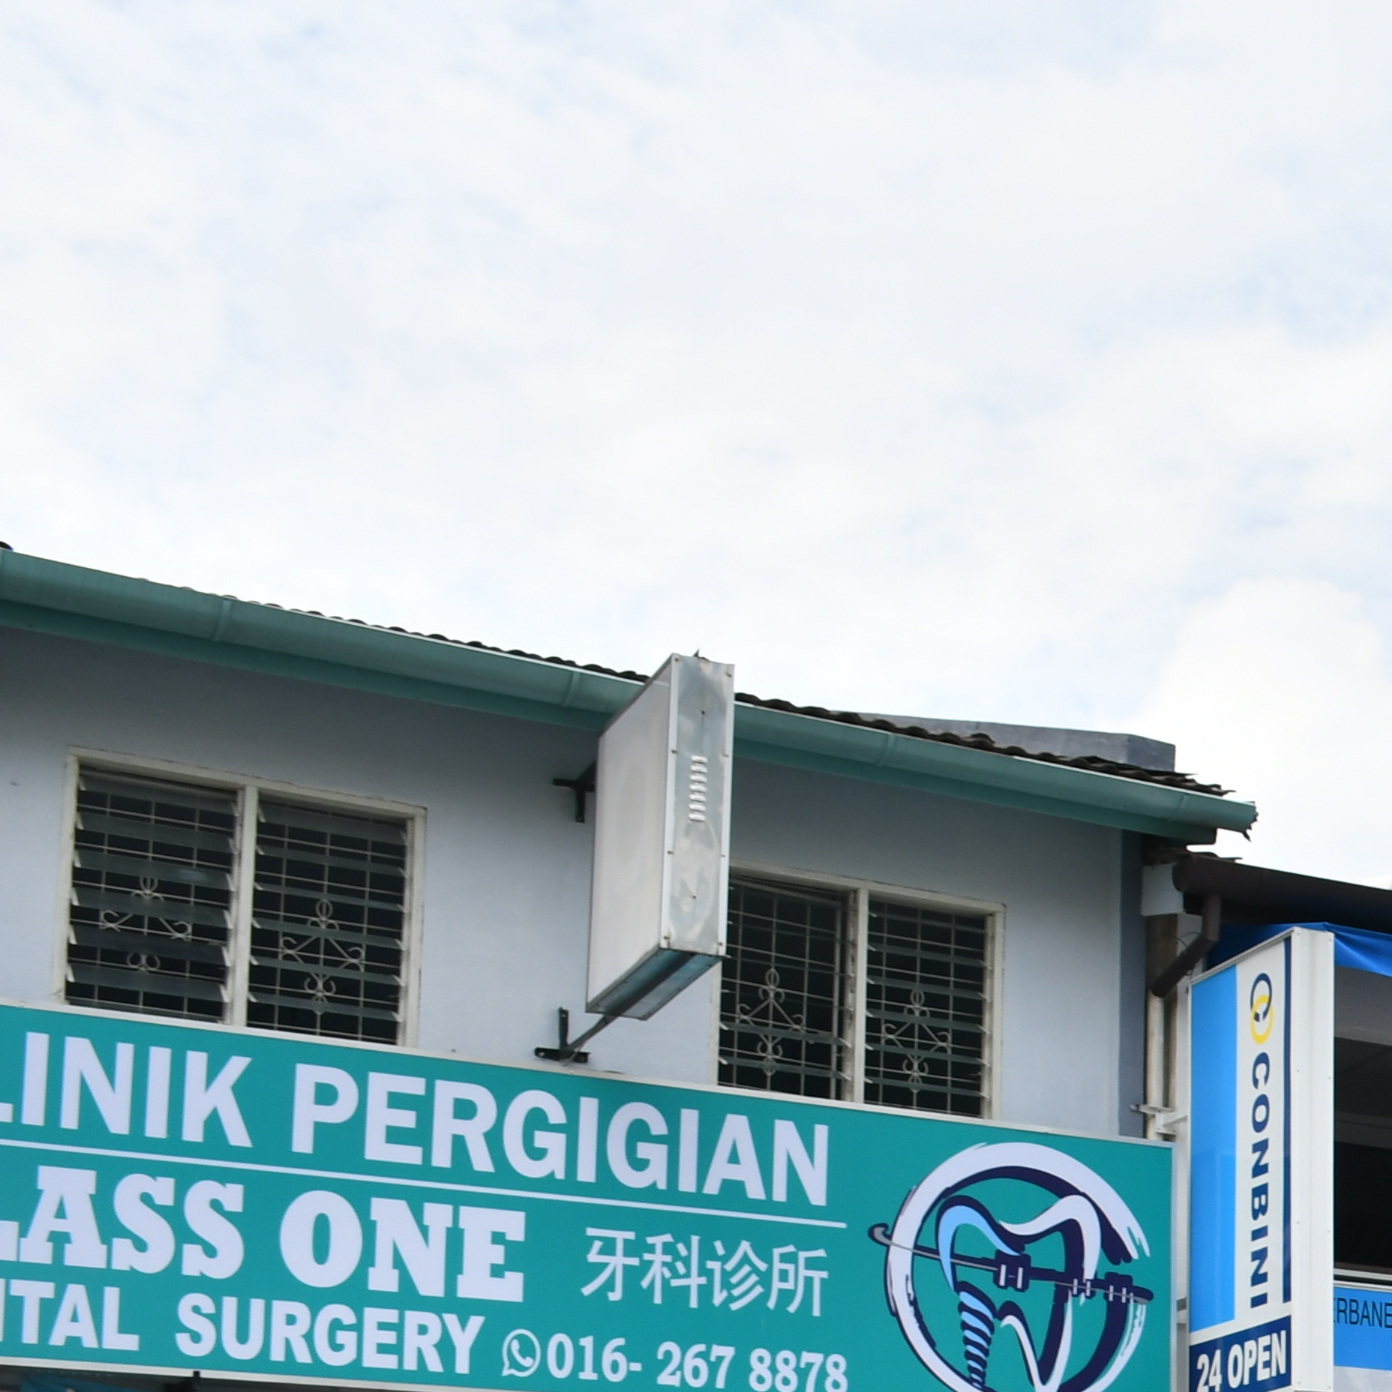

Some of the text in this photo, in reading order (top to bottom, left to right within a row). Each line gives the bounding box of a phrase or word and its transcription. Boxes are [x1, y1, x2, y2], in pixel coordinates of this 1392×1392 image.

[0, 1031, 830, 1205] INIK PERGIGIAN
[1250, 1051, 1271, 1309] CONBINI
[0, 1165, 526, 1303] ASS ONE
[581, 1225, 830, 1318] 牙科诊所
[0, 1278, 485, 1374] TAL SURGERY
[660, 1341, 729, 1390] 267
[1227, 1330, 1287, 1390] OPEN
